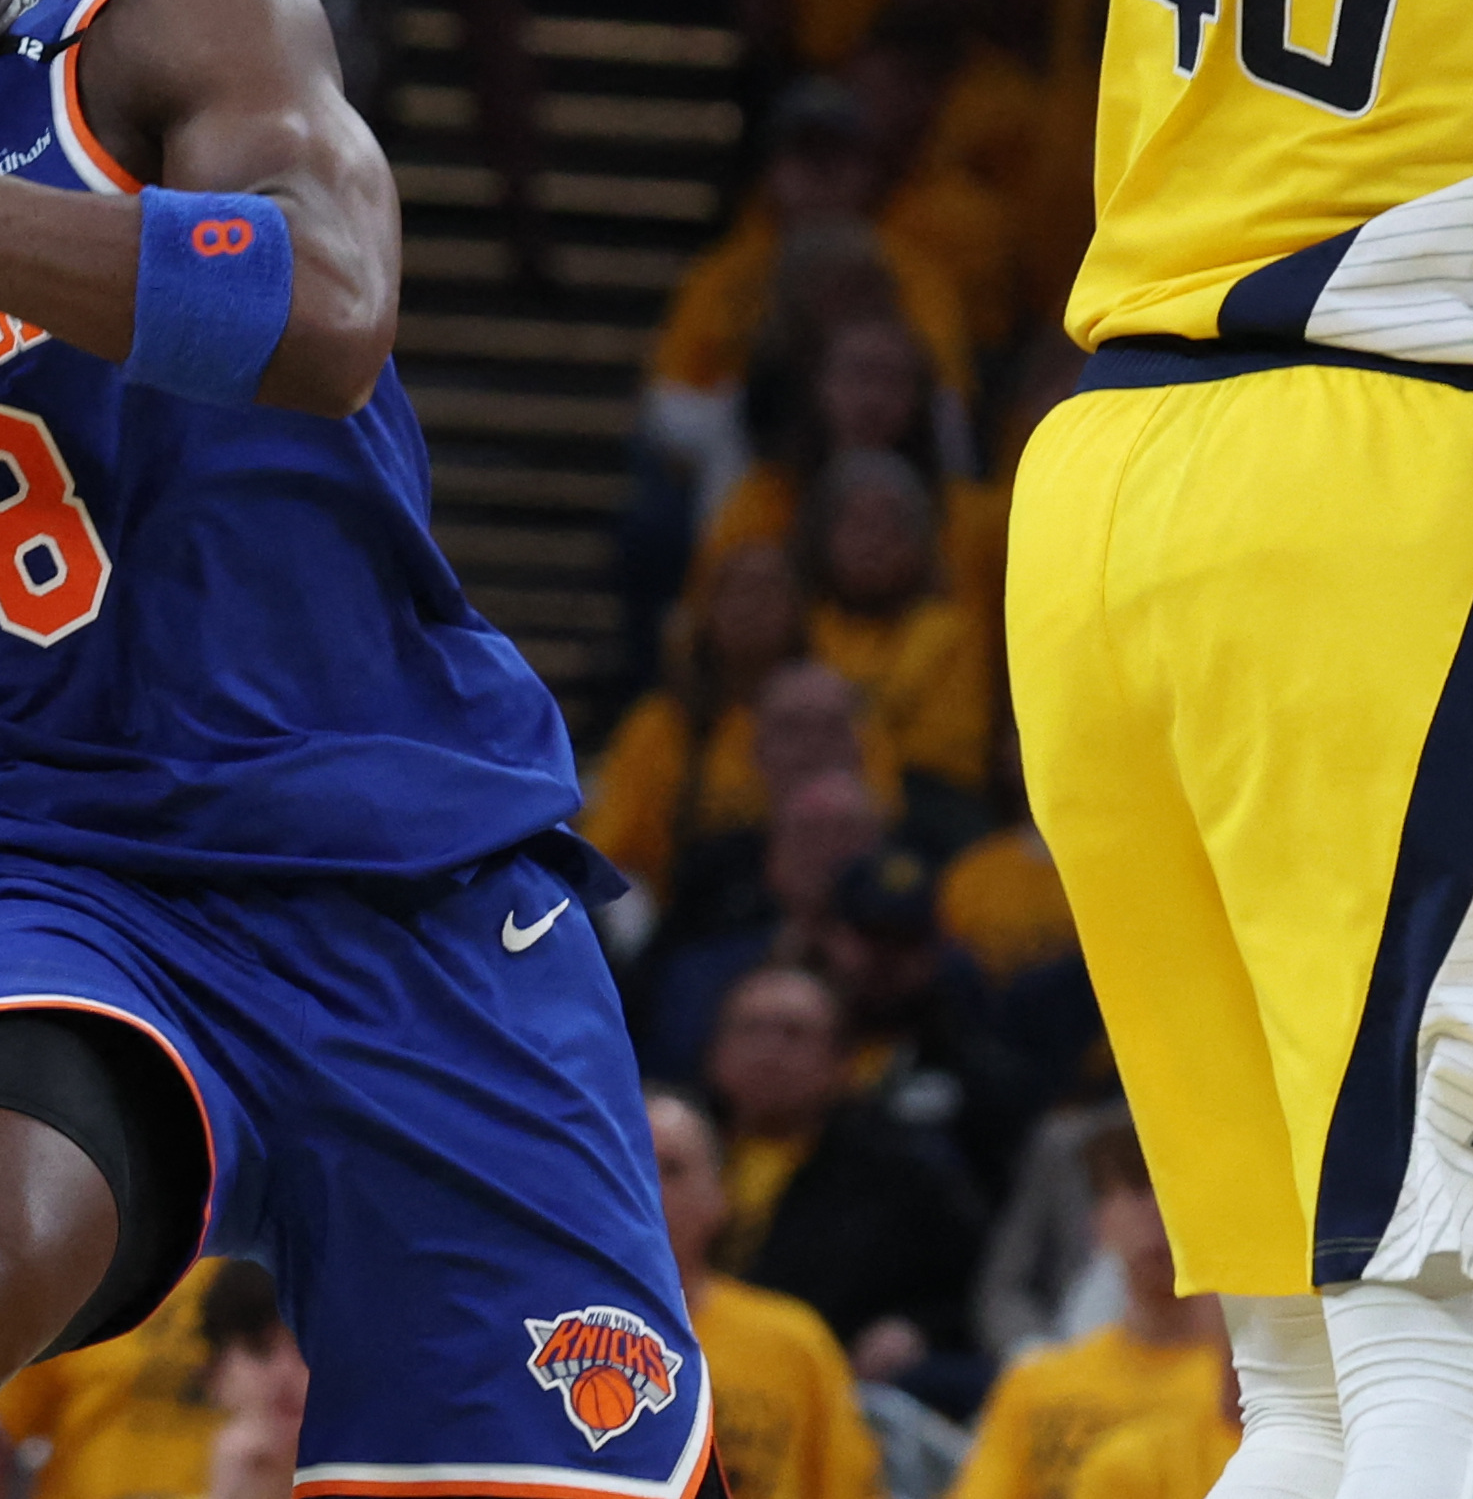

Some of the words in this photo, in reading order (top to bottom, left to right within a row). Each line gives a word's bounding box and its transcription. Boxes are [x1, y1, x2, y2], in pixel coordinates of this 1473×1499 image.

[17, 35, 44, 62] 12
[191, 218, 253, 257] 8
[585, 1311, 612, 1326] NEW
[533, 1317, 671, 1396] KNICKS
